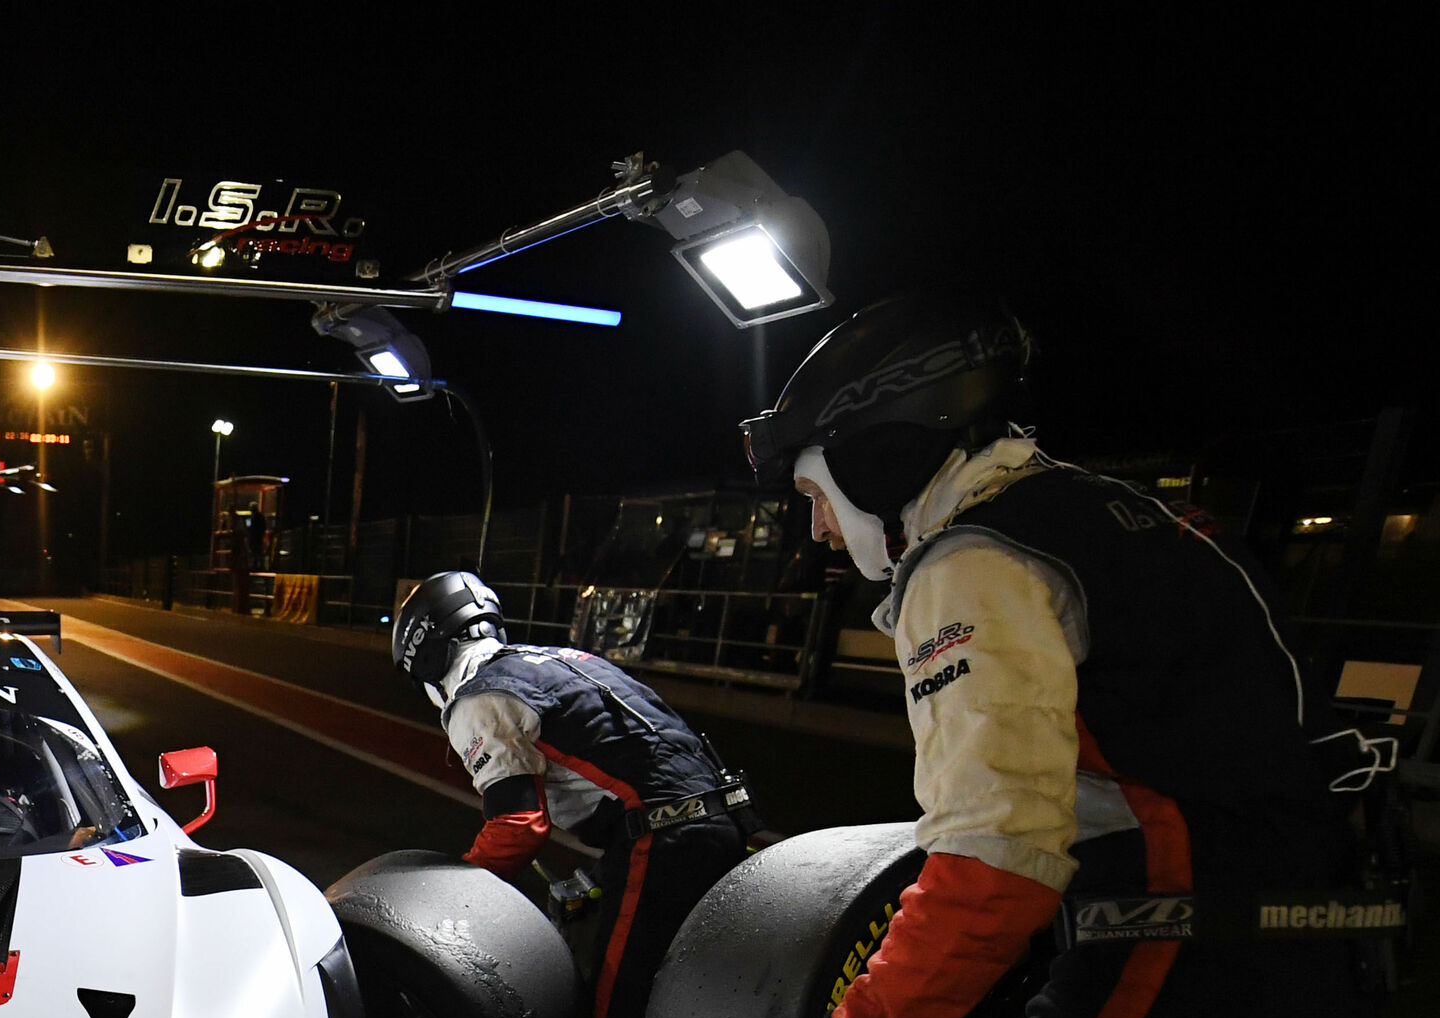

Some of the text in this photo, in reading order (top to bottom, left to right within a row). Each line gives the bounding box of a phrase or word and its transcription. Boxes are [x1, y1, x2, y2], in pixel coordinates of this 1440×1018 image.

[148, 177, 366, 239] I.S.R.
[237, 236, 356, 263] racing
[401, 614, 436, 674] uvex
[910, 658, 971, 705] KOBRA
[826, 902, 895, 1011] RELLI
